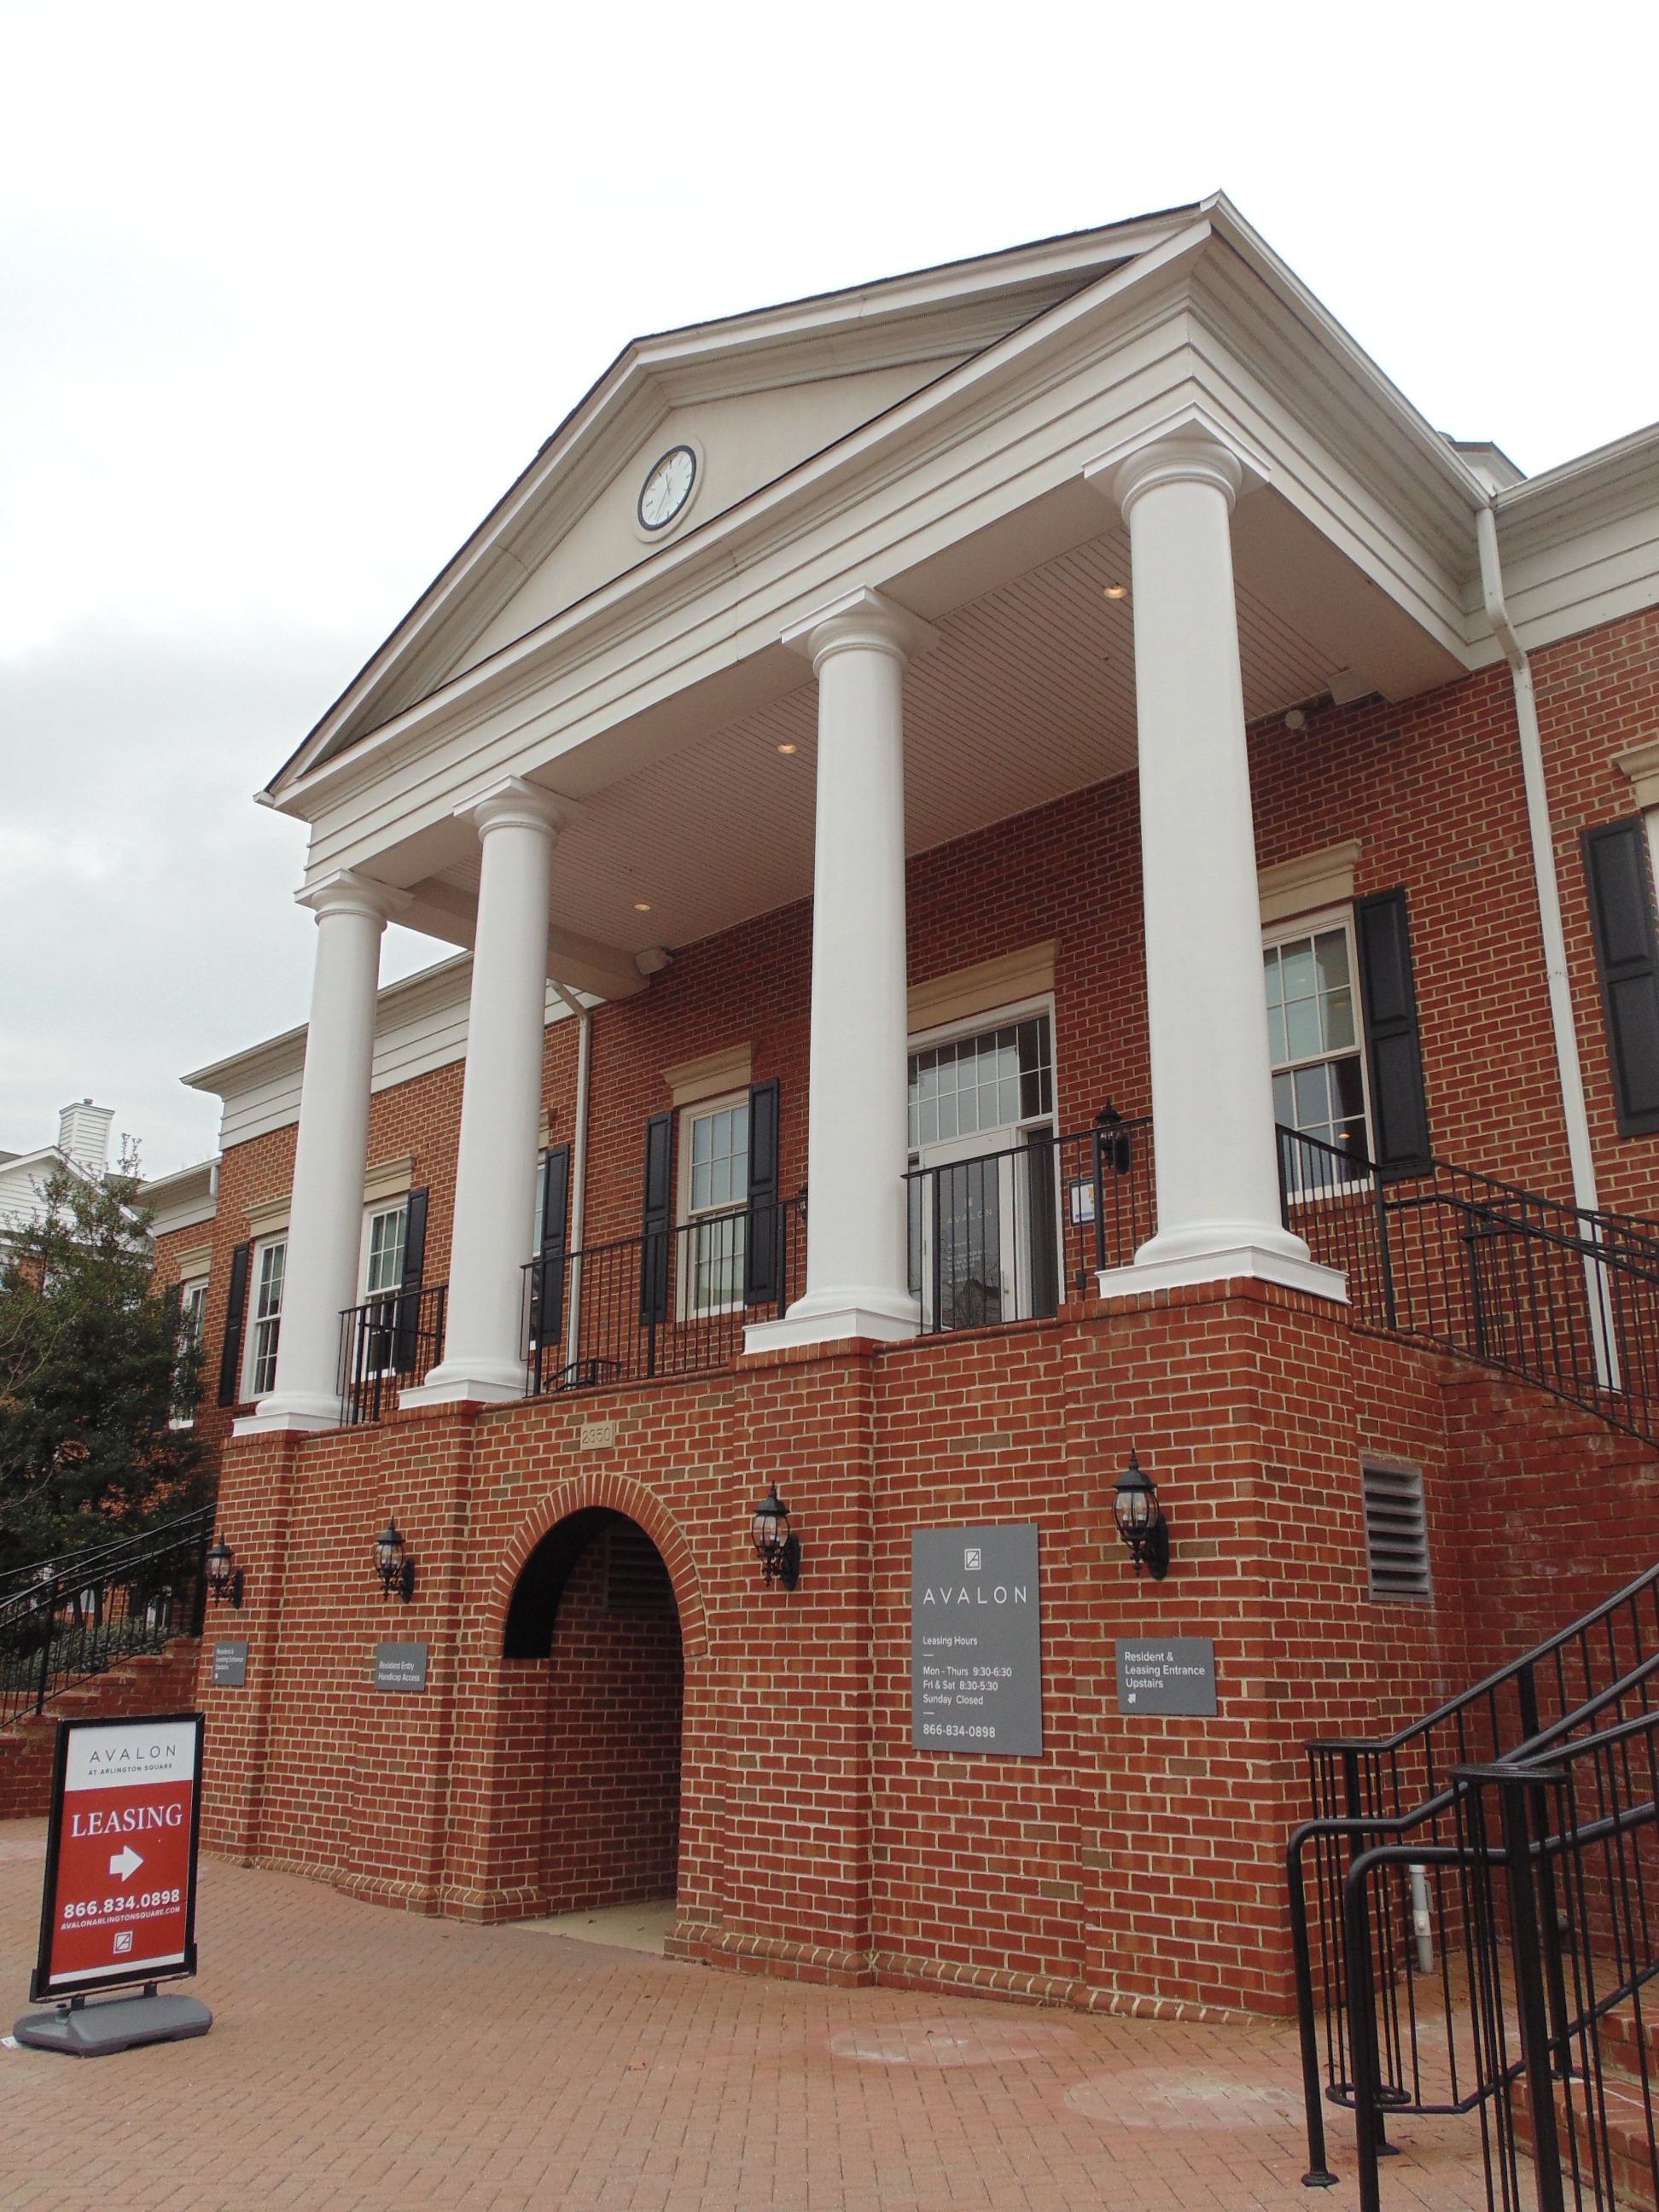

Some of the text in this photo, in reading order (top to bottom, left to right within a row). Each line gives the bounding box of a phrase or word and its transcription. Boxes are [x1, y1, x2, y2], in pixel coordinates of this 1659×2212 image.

[946, 1208, 992, 1225] AVALON
[582, 1427, 611, 1444] 2350
[923, 1586, 1027, 1604] AVALON
[923, 1636, 978, 1647] Leasing Hours
[1124, 1651, 1173, 1662] Resident &
[379, 1661, 415, 1671] Resident Entry
[923, 1666, 940, 1675] Mon
[946, 1667, 969, 1676] Thurs
[973, 1667, 1012, 1677] 9:30-6:30
[1125, 1665, 1206, 1677] Leasing Entrance
[378, 1673, 420, 1683] Handicap Access
[1126, 1678, 1164, 1689] Upstairs
[923, 1679, 998, 1691] Fri & Sat 8:30-5:30
[923, 1694, 984, 1705] Sunday Closed
[923, 1724, 996, 1738] 866-834-0898
[89, 1744, 176, 1764] AVALON
[100, 1765, 143, 1775] ARLINGTON
[144, 1762, 173, 1771] SQUARE
[71, 1802, 183, 1837] LEASING
[63, 1889, 180, 1919] 866.834.0898
[61, 1906, 181, 1930] AVALONARLINGTONSQUARE.COM
